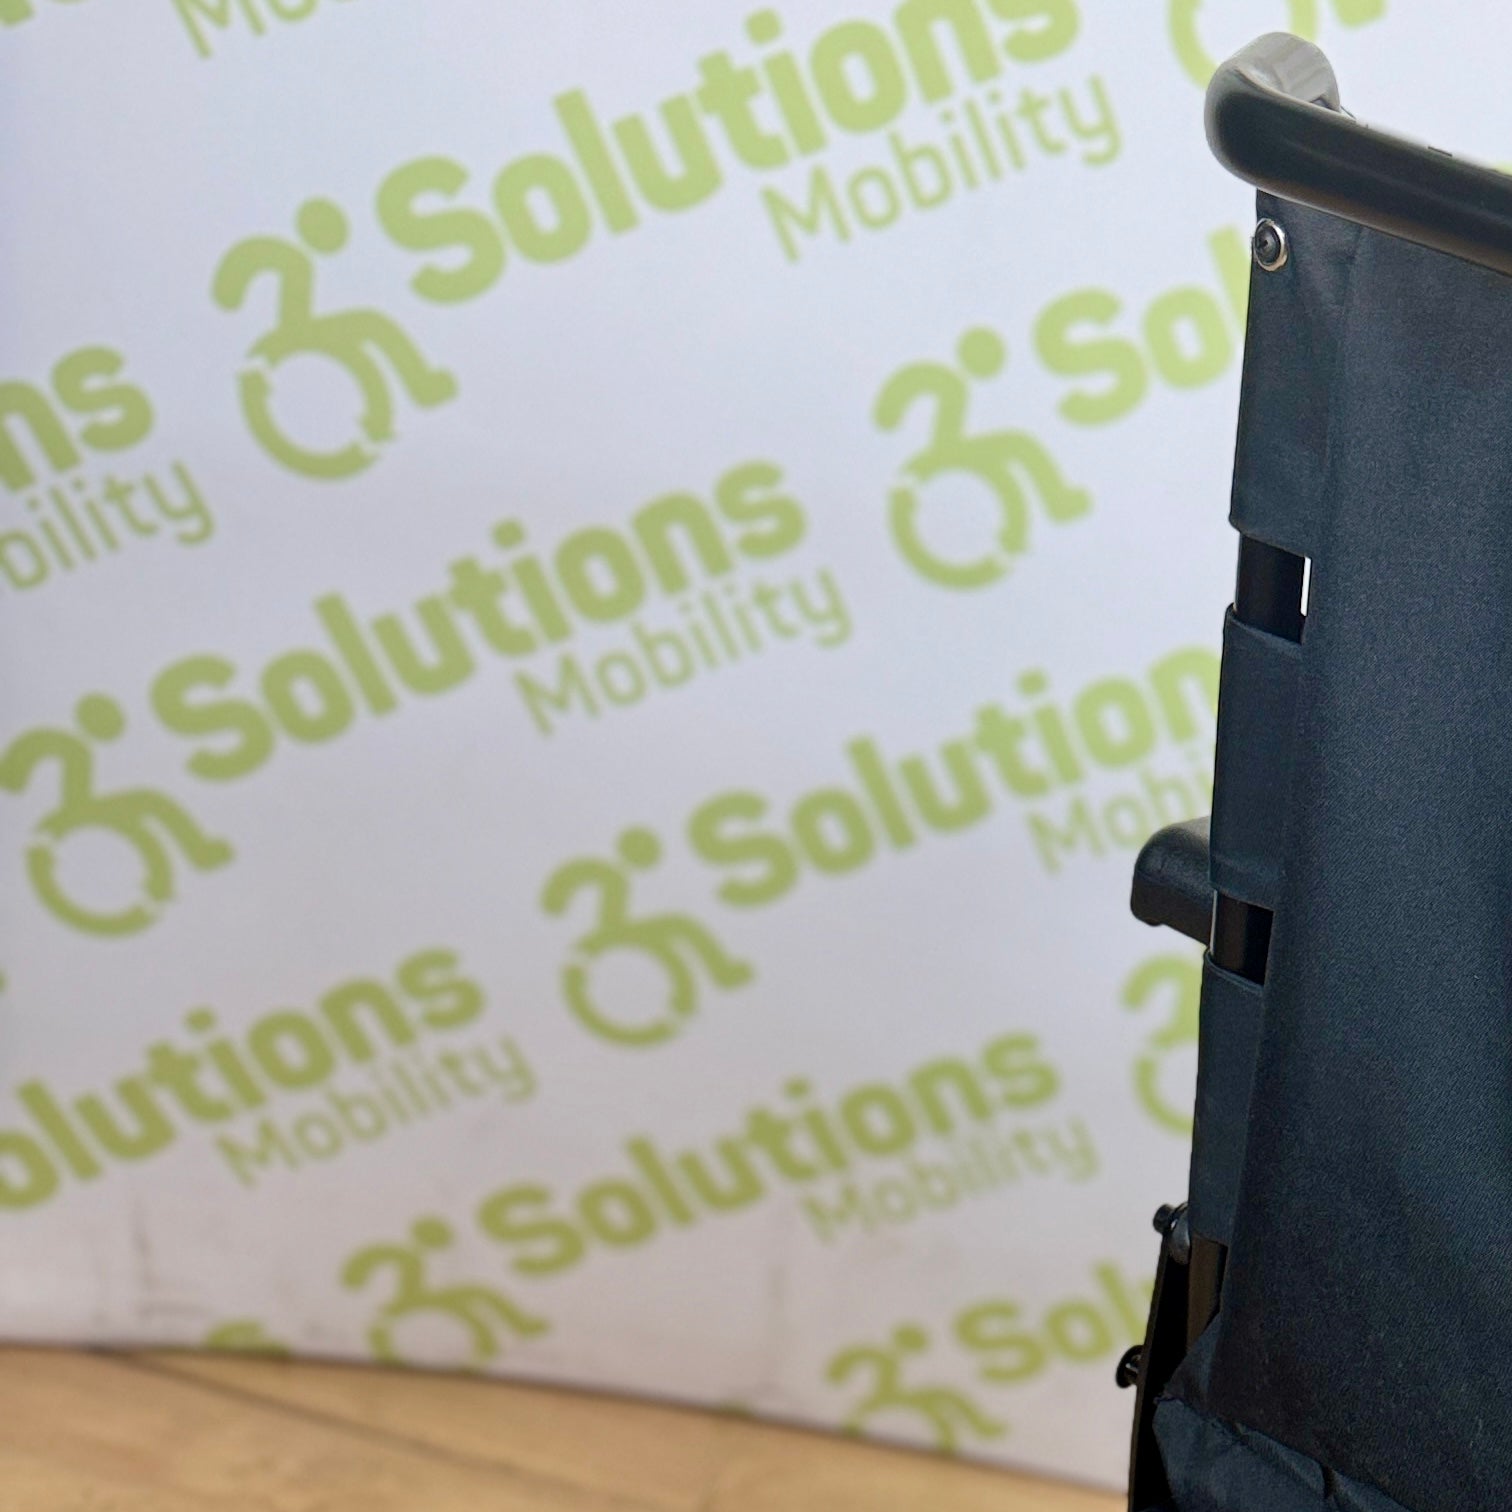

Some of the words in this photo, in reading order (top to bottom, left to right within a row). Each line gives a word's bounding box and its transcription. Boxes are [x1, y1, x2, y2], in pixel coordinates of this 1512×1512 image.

[376, 0, 1080, 302] Solutions
[763, 77, 1121, 260] Mobility
[150, 461, 806, 781] Solutions
[507, 573, 850, 731] Mobility
[213, 1036, 537, 1187] Mobility
[475, 1033, 1060, 1279] Solutions
[801, 1115, 1098, 1243] Mobility
